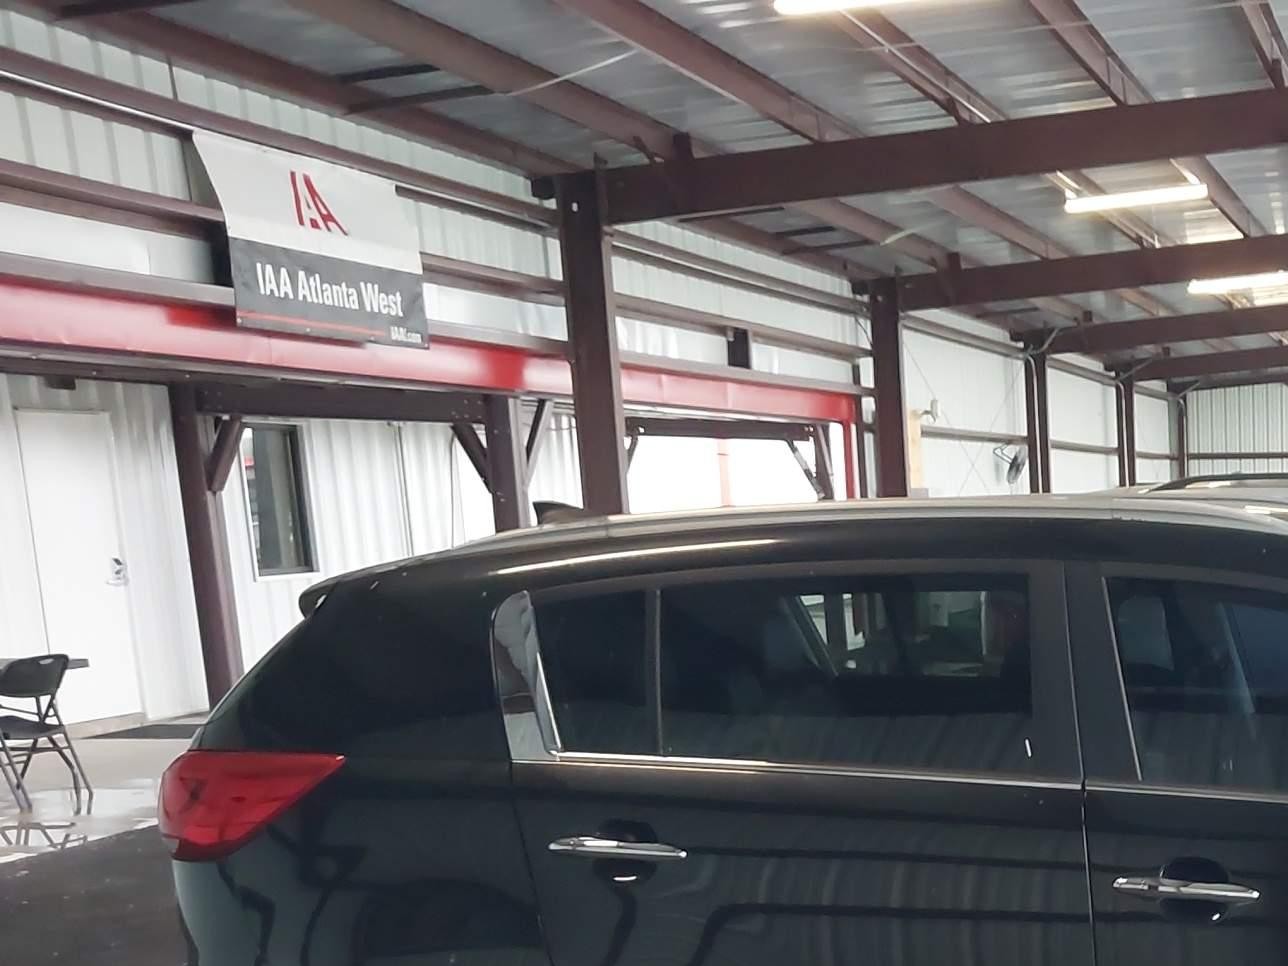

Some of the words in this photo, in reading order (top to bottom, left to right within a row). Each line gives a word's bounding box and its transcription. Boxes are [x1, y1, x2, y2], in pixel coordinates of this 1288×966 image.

[256, 262, 294, 299] IAA
[298, 270, 359, 310] Atlanta
[360, 281, 403, 317] West
